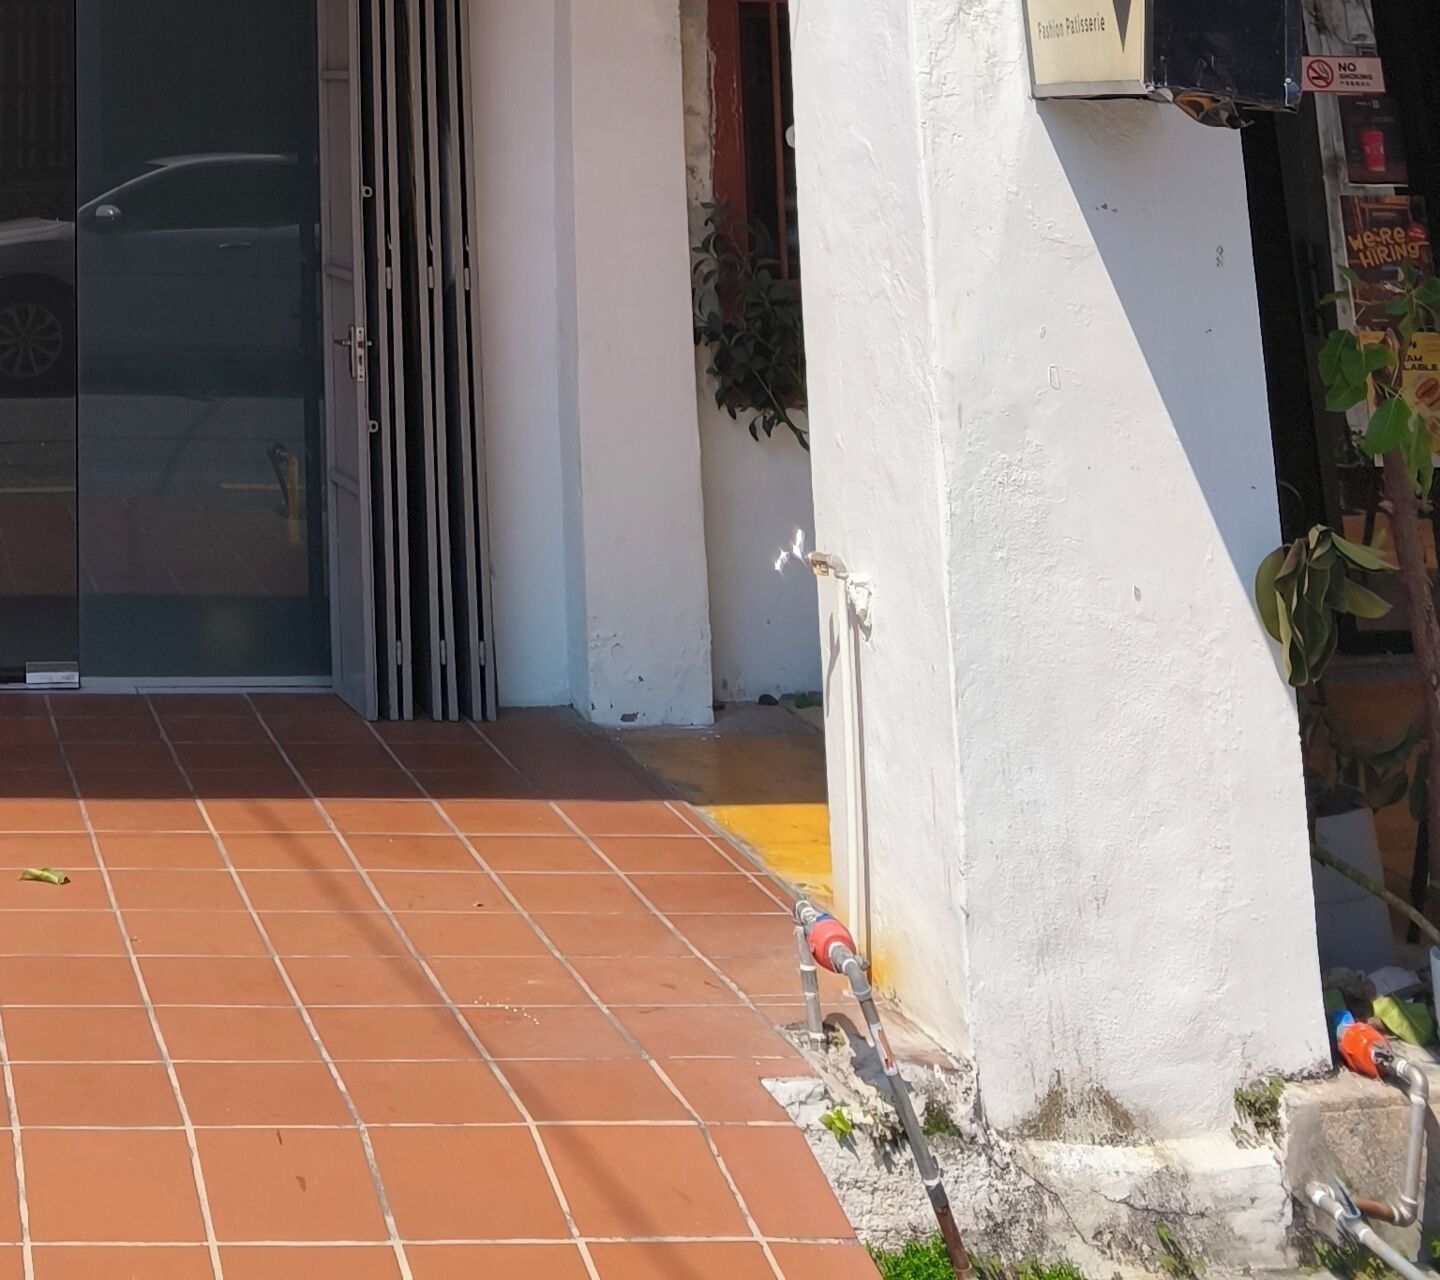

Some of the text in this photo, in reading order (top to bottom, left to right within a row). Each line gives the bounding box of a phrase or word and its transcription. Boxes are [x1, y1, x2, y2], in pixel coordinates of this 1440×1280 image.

[1037, 12, 1106, 40] Fashion Patisserie
[1338, 62, 1357, 72] NO
